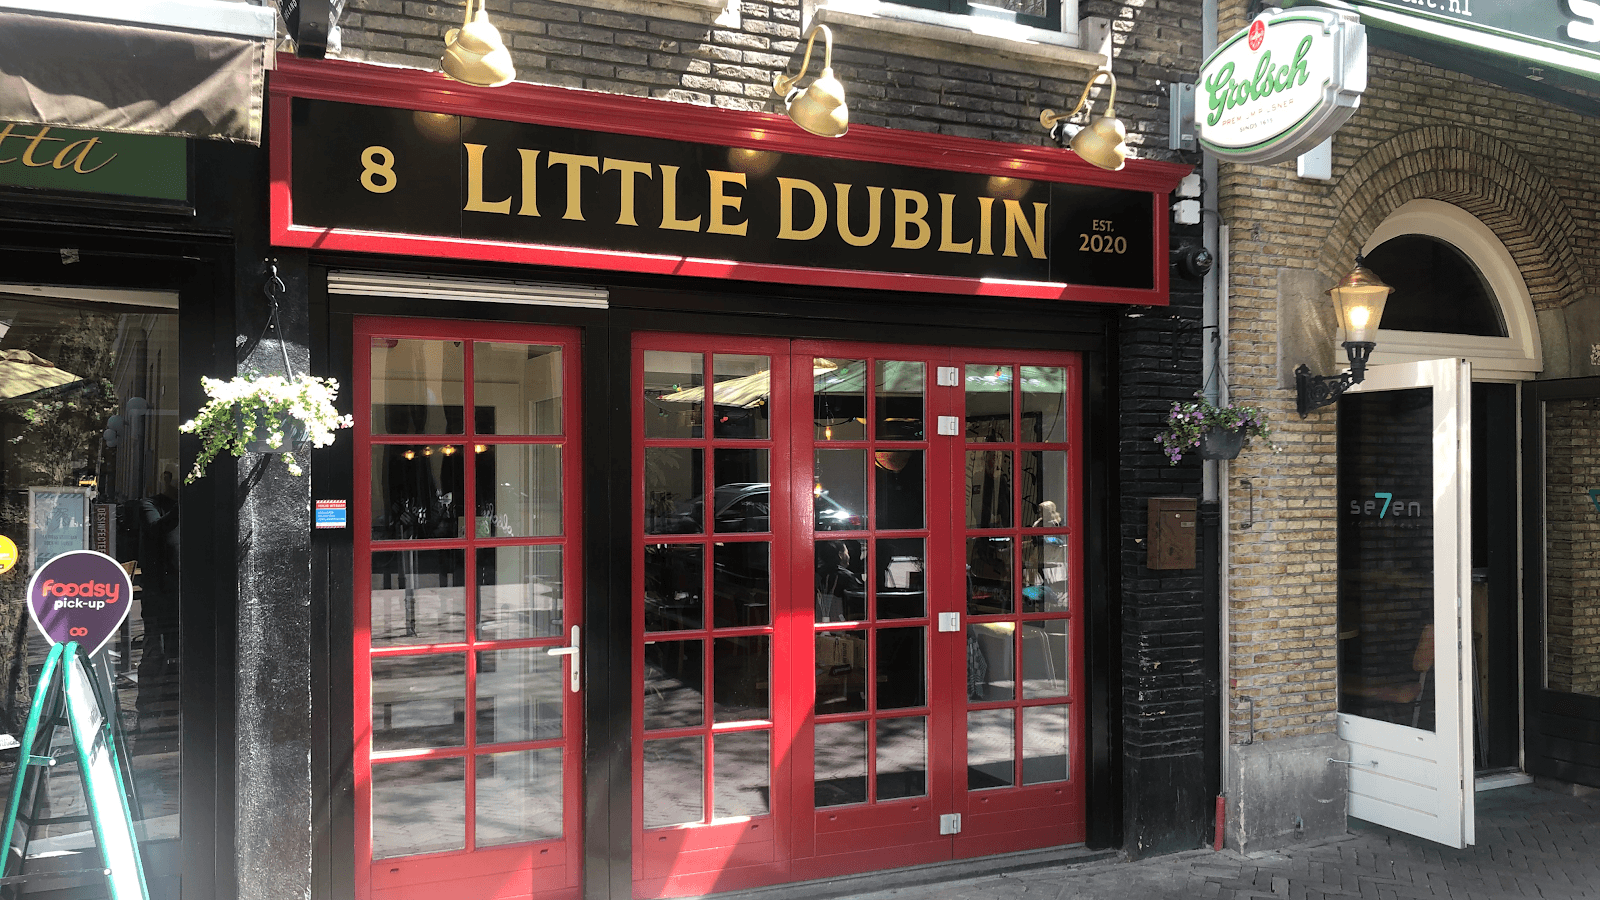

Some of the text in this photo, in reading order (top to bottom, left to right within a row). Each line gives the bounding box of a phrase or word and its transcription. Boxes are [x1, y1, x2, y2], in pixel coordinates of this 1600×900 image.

[1204, 35, 1313, 126] Grolsch
[1239, 122, 1258, 133] SINDS
[360, 145, 398, 193] 8
[463, 142, 1048, 260] LITTLE DUBLIN
[1092, 219, 1114, 233] EST.
[1078, 233, 1127, 254] 2020
[1350, 492, 1421, 519] se7en
[42, 579, 120, 604] foodsy
[54, 597, 105, 610] pick-up
